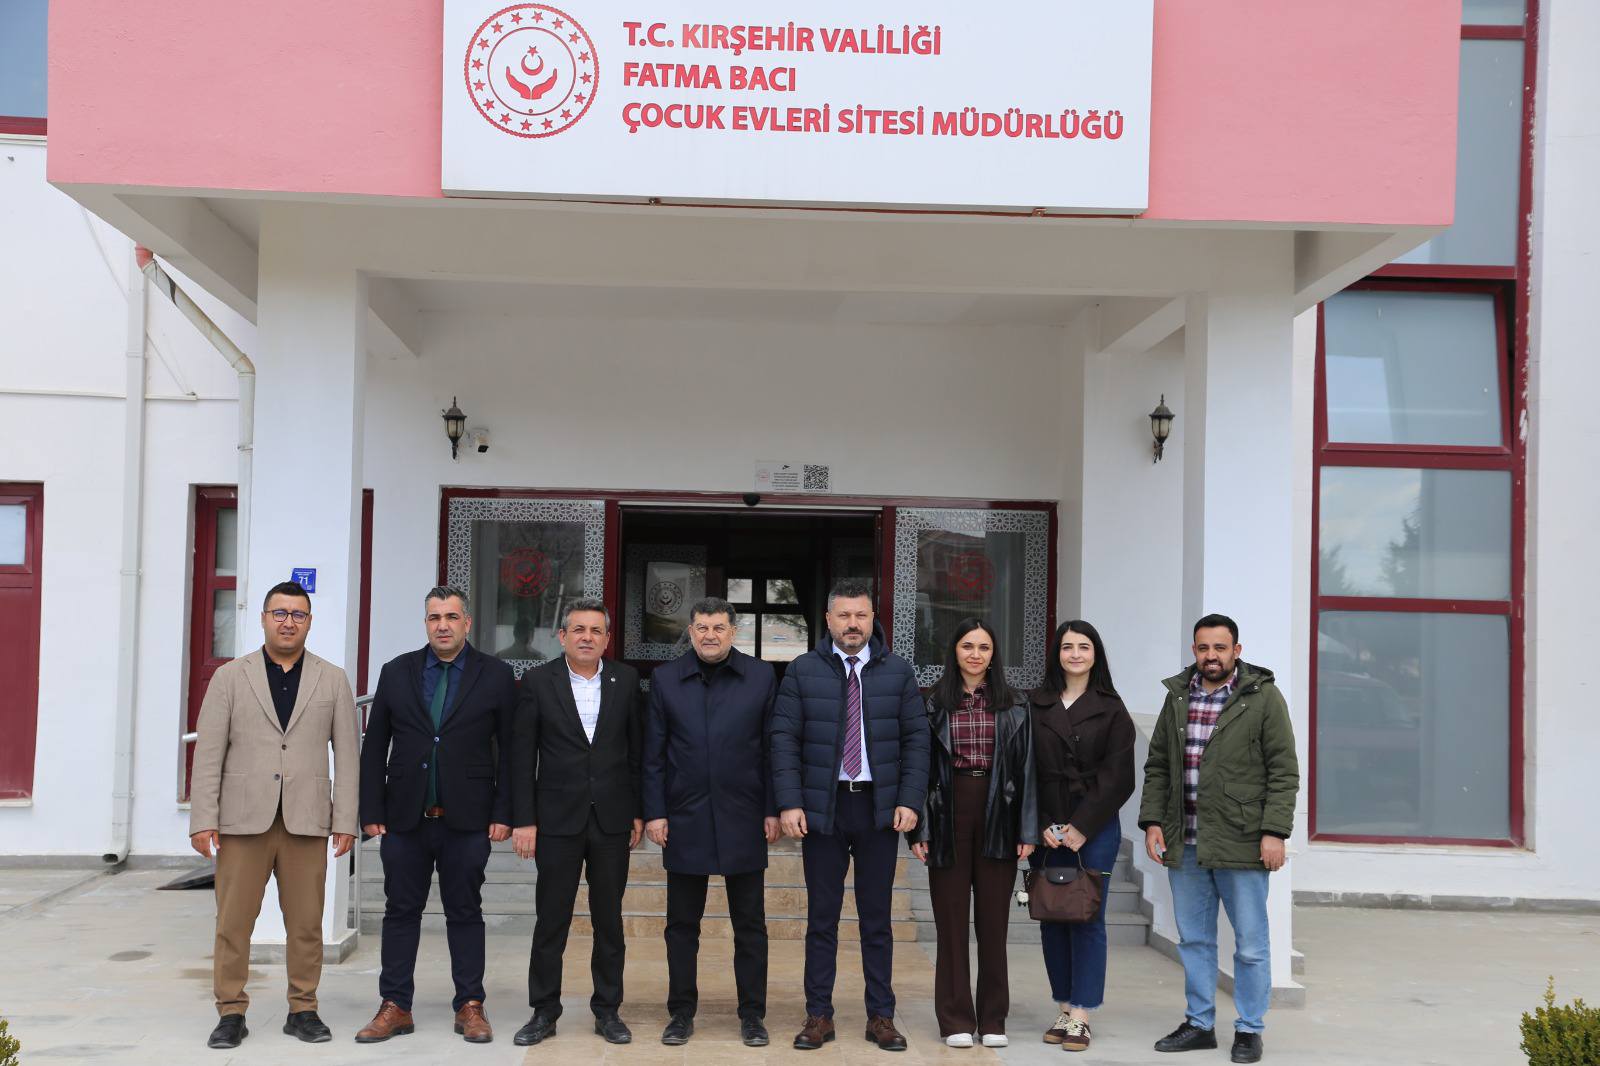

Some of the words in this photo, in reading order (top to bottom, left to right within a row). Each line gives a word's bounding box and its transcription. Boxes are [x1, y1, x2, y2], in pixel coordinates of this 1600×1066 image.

[623, 21, 674, 48] T.C.
[682, 22, 815, 57] KIRŞEHİR
[819, 24, 941, 56] VALİLİĞİ
[623, 62, 722, 90] FATMA
[729, 65, 797, 93] BACI
[622, 102, 725, 134] ÇOCUK
[731, 103, 830, 133] EVLERİ
[838, 104, 925, 136] SİTESİ
[932, 106, 1124, 140] MÜDÜRLÜĞÜ
[298, 576, 309, 585] 71
